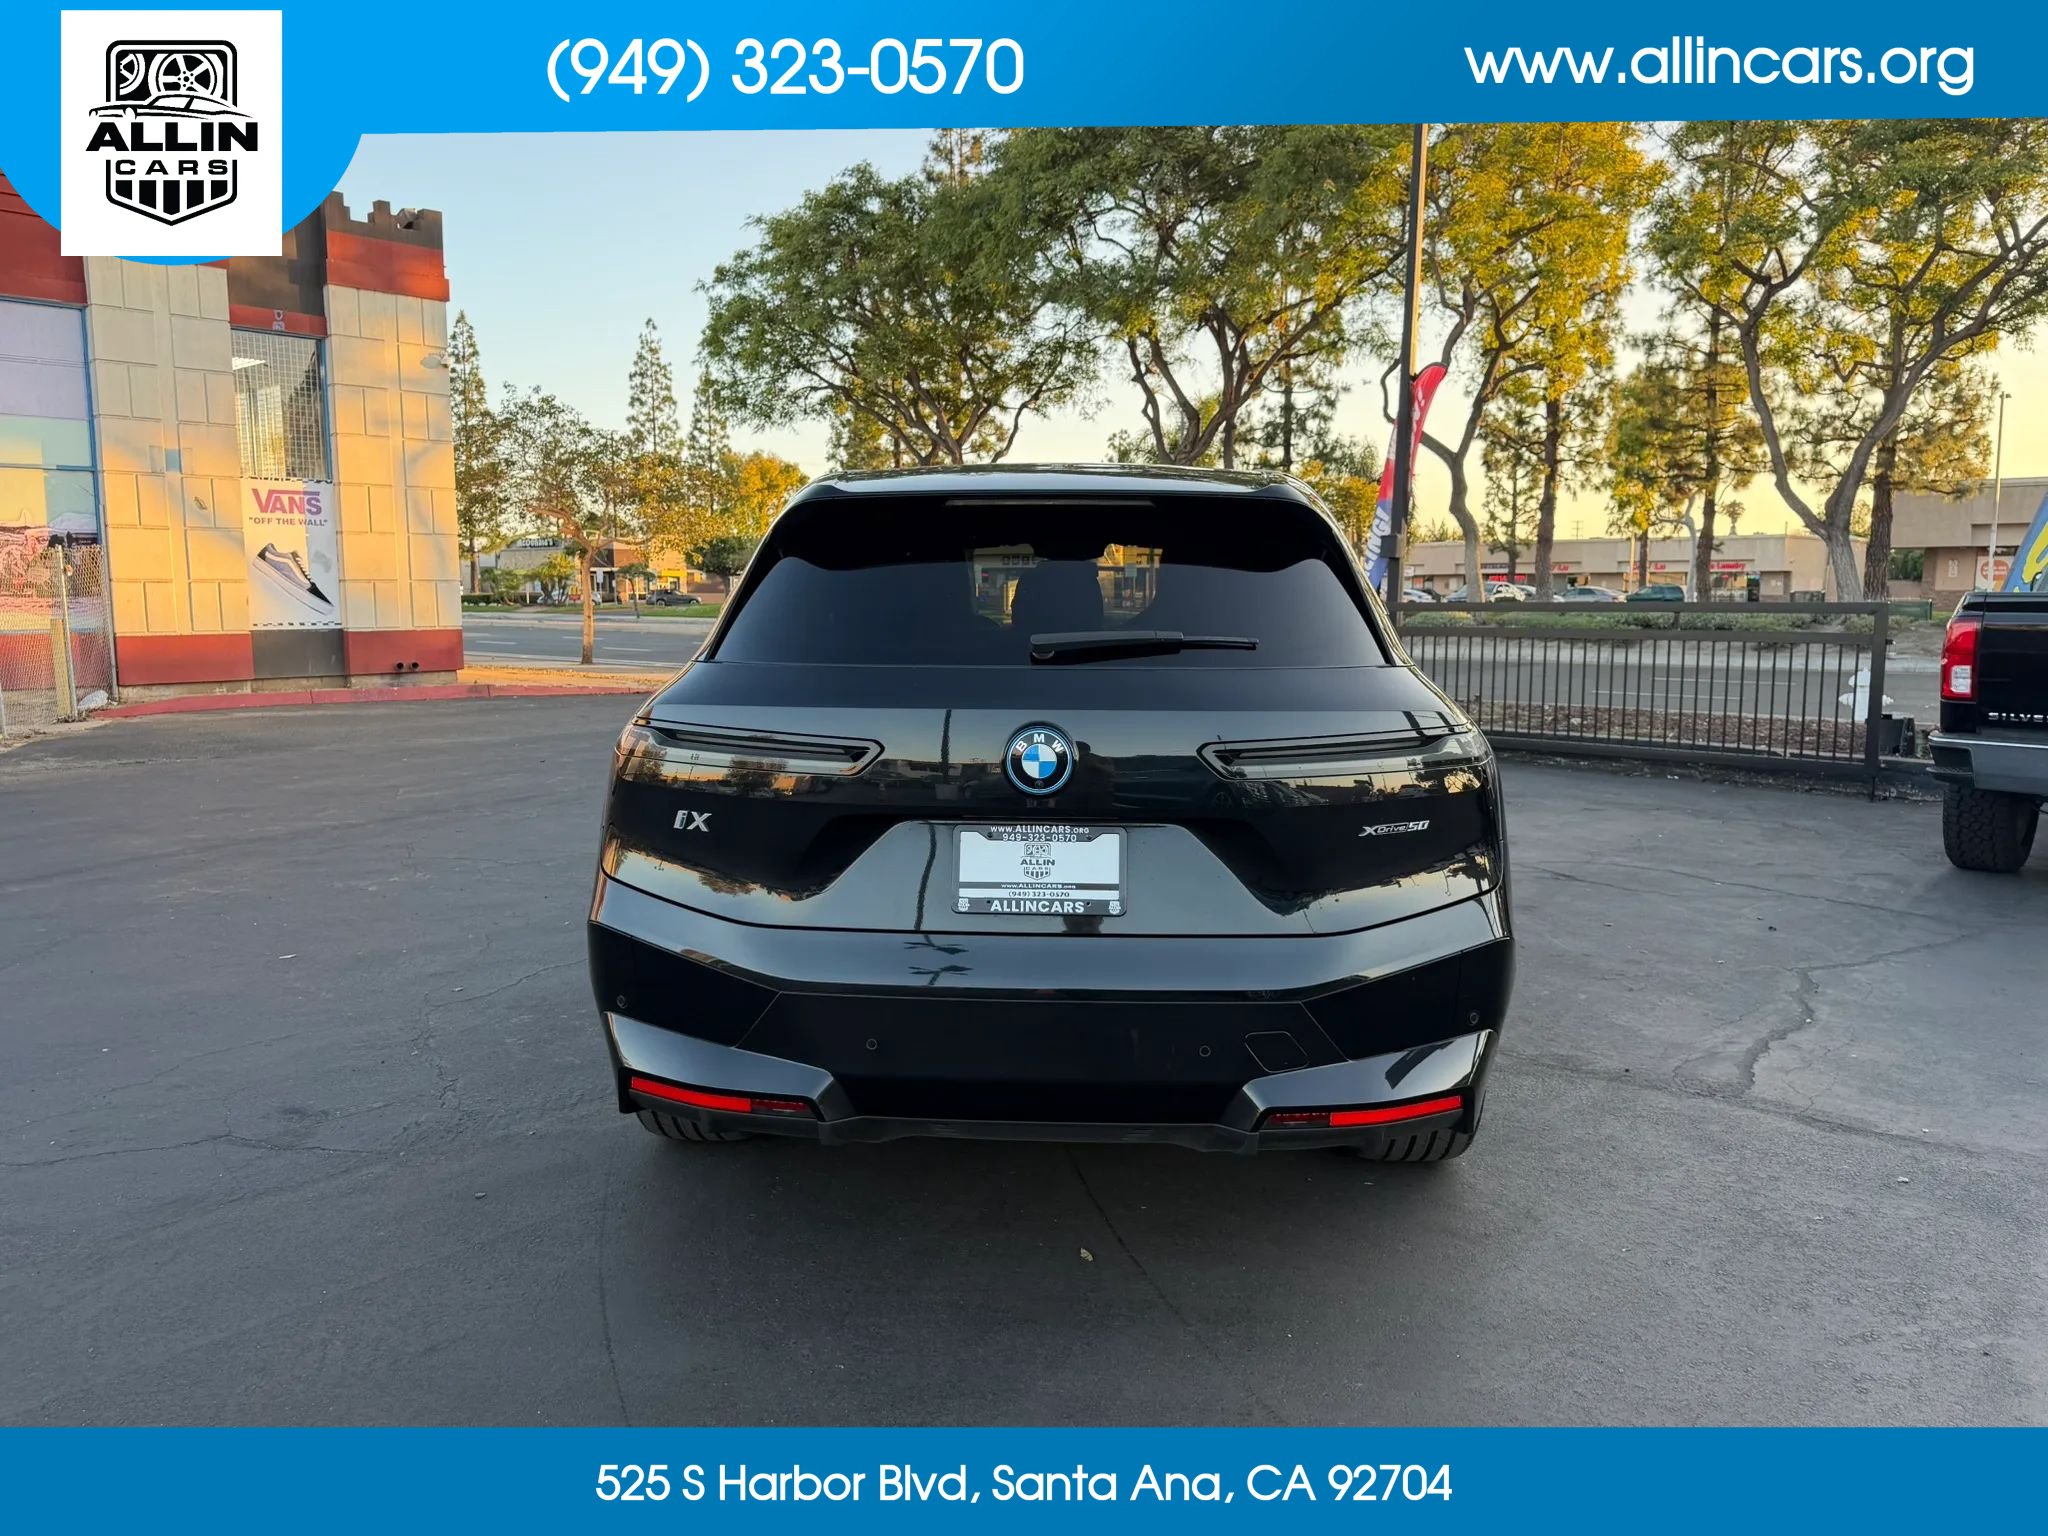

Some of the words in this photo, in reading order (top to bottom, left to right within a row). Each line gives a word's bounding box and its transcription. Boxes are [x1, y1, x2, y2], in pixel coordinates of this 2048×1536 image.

[252, 488, 322, 516] VANS
[275, 518, 296, 526] THE
[1988, 711, 2048, 722] SILVE
[1016, 733, 1064, 753] BMW
[1002, 833, 1077, 842] 949-323-0570
[990, 899, 1085, 913] ALLINCARS
